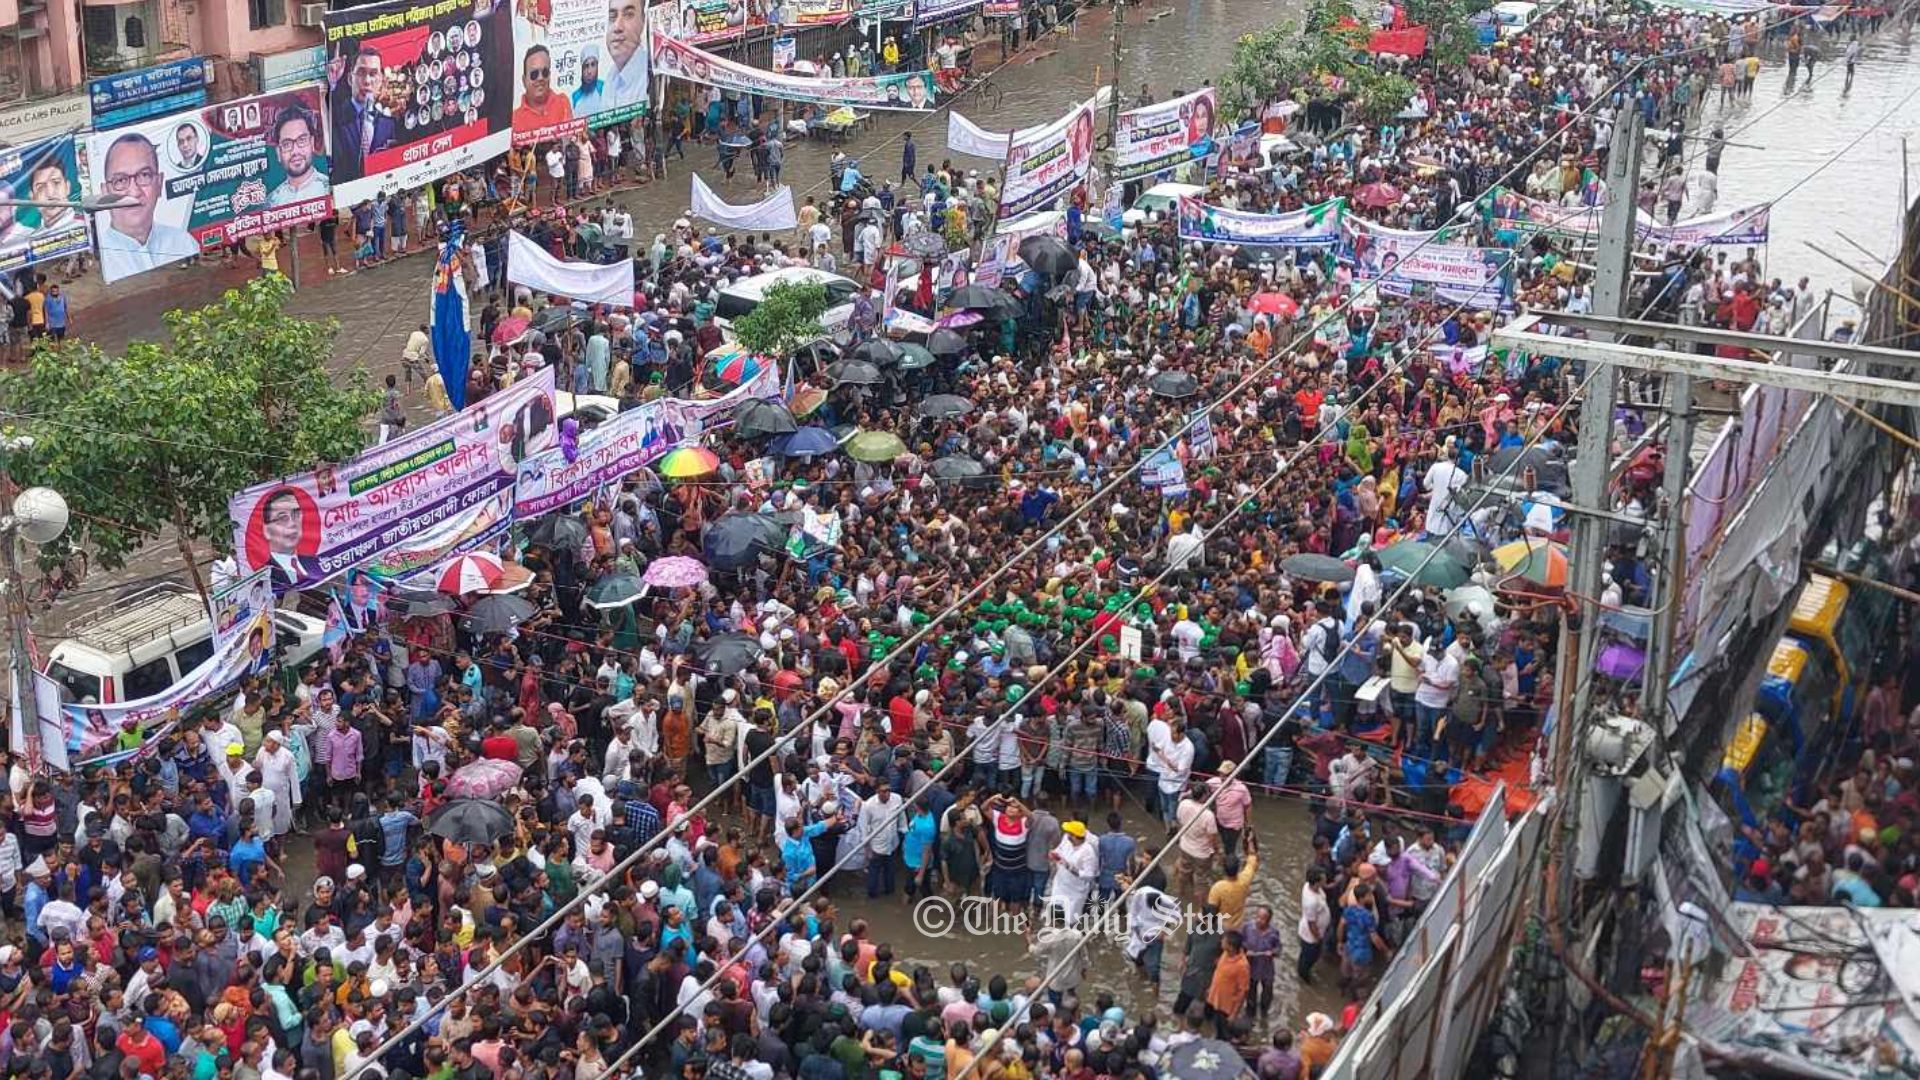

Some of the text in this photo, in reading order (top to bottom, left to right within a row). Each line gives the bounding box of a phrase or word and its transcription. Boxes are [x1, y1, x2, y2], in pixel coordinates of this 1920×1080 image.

[325, 500, 360, 529] মোঃ
[366, 471, 428, 506] আব্বাস
[382, 498, 459, 544] জাতীয়তাবাদী
[462, 480, 499, 508] ফোরাম
